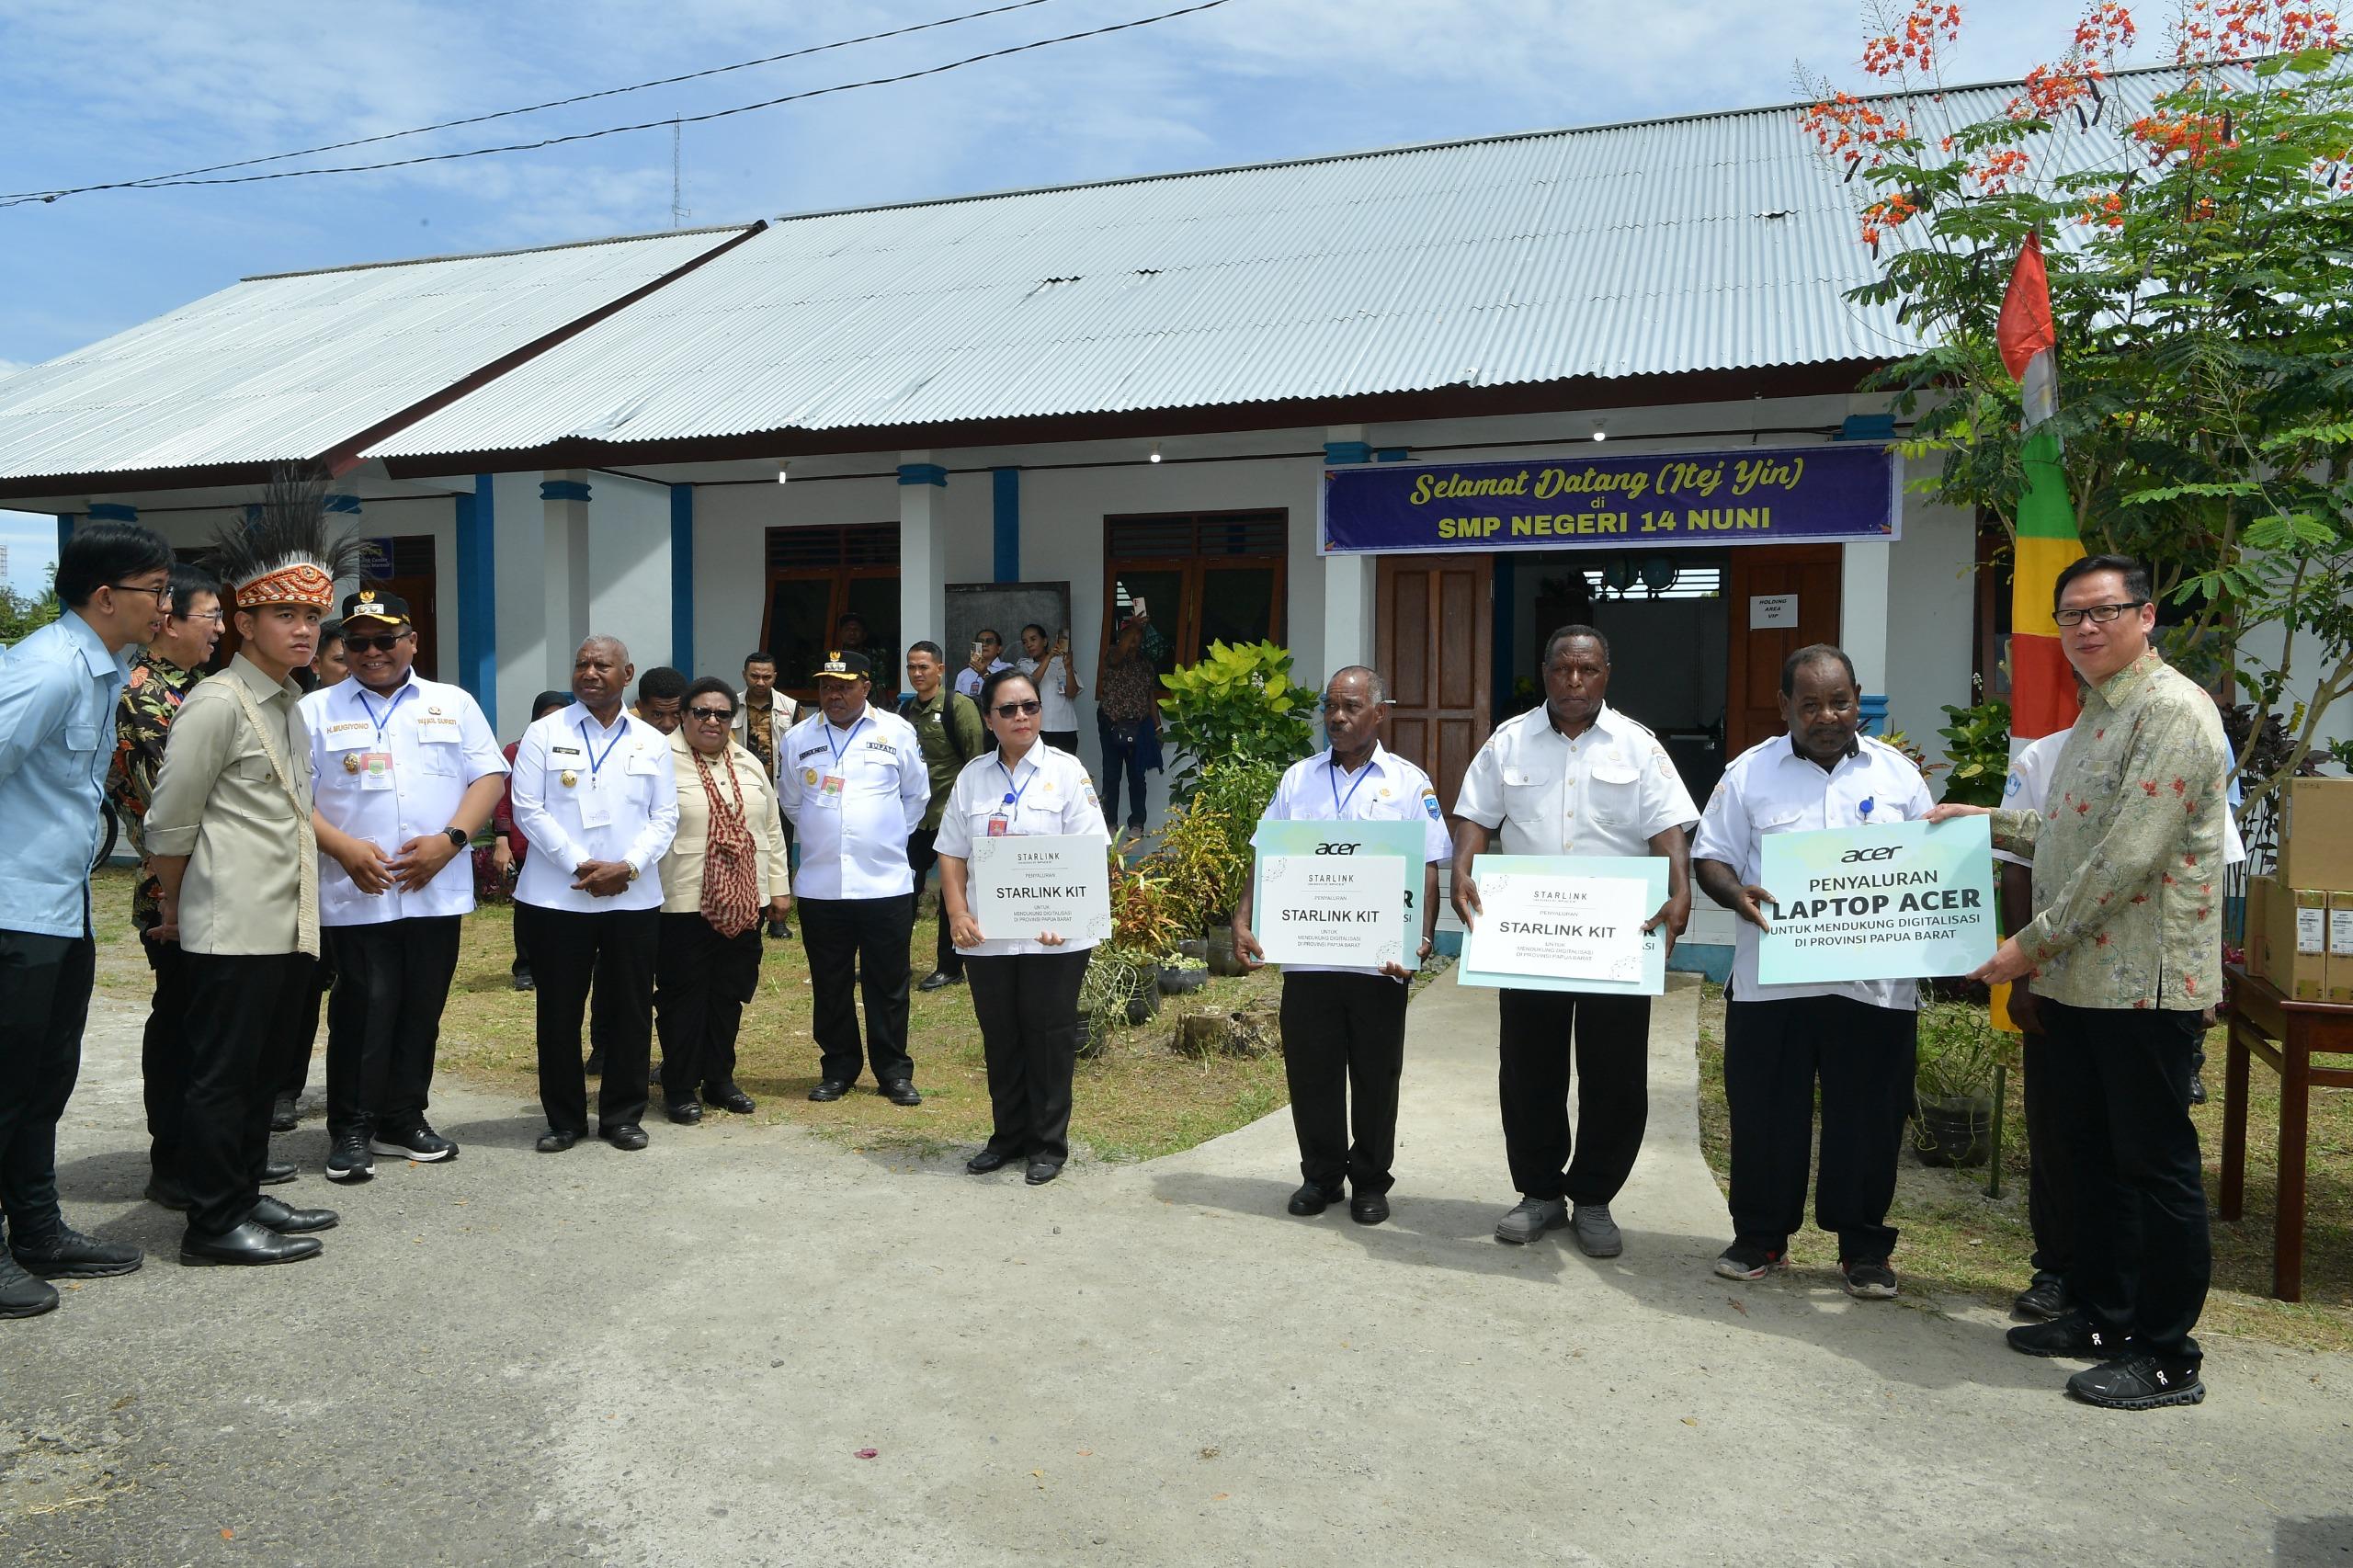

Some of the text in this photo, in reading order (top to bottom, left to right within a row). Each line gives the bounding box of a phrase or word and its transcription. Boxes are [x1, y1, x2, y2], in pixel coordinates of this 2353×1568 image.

[1410, 458, 1803, 505] Selamat Datang (Itej Yin)
[1590, 496, 1605, 508] di
[1438, 507, 1770, 538] SMP NEGERI 14 NUNI
[869, 743, 894, 754] BUPATI
[1314, 843, 1361, 856] acer
[1840, 846, 1903, 863] acer
[1308, 874, 1354, 882] STARLINK
[1810, 869, 1938, 892] PENYALURAN
[996, 886, 1086, 899] STARLINK KIT
[1533, 891, 1587, 901] STARLINK
[1772, 889, 1981, 920] LAPTOP ACER
[1281, 909, 1380, 923] STARLINK KIT
[1499, 921, 1616, 938] STARLINK KIT
[1770, 914, 1980, 936] UNTUK MENDUKUNG DIGITALISASI
[1795, 929, 1956, 947] DI PROVINSI PAPUA BARAT
